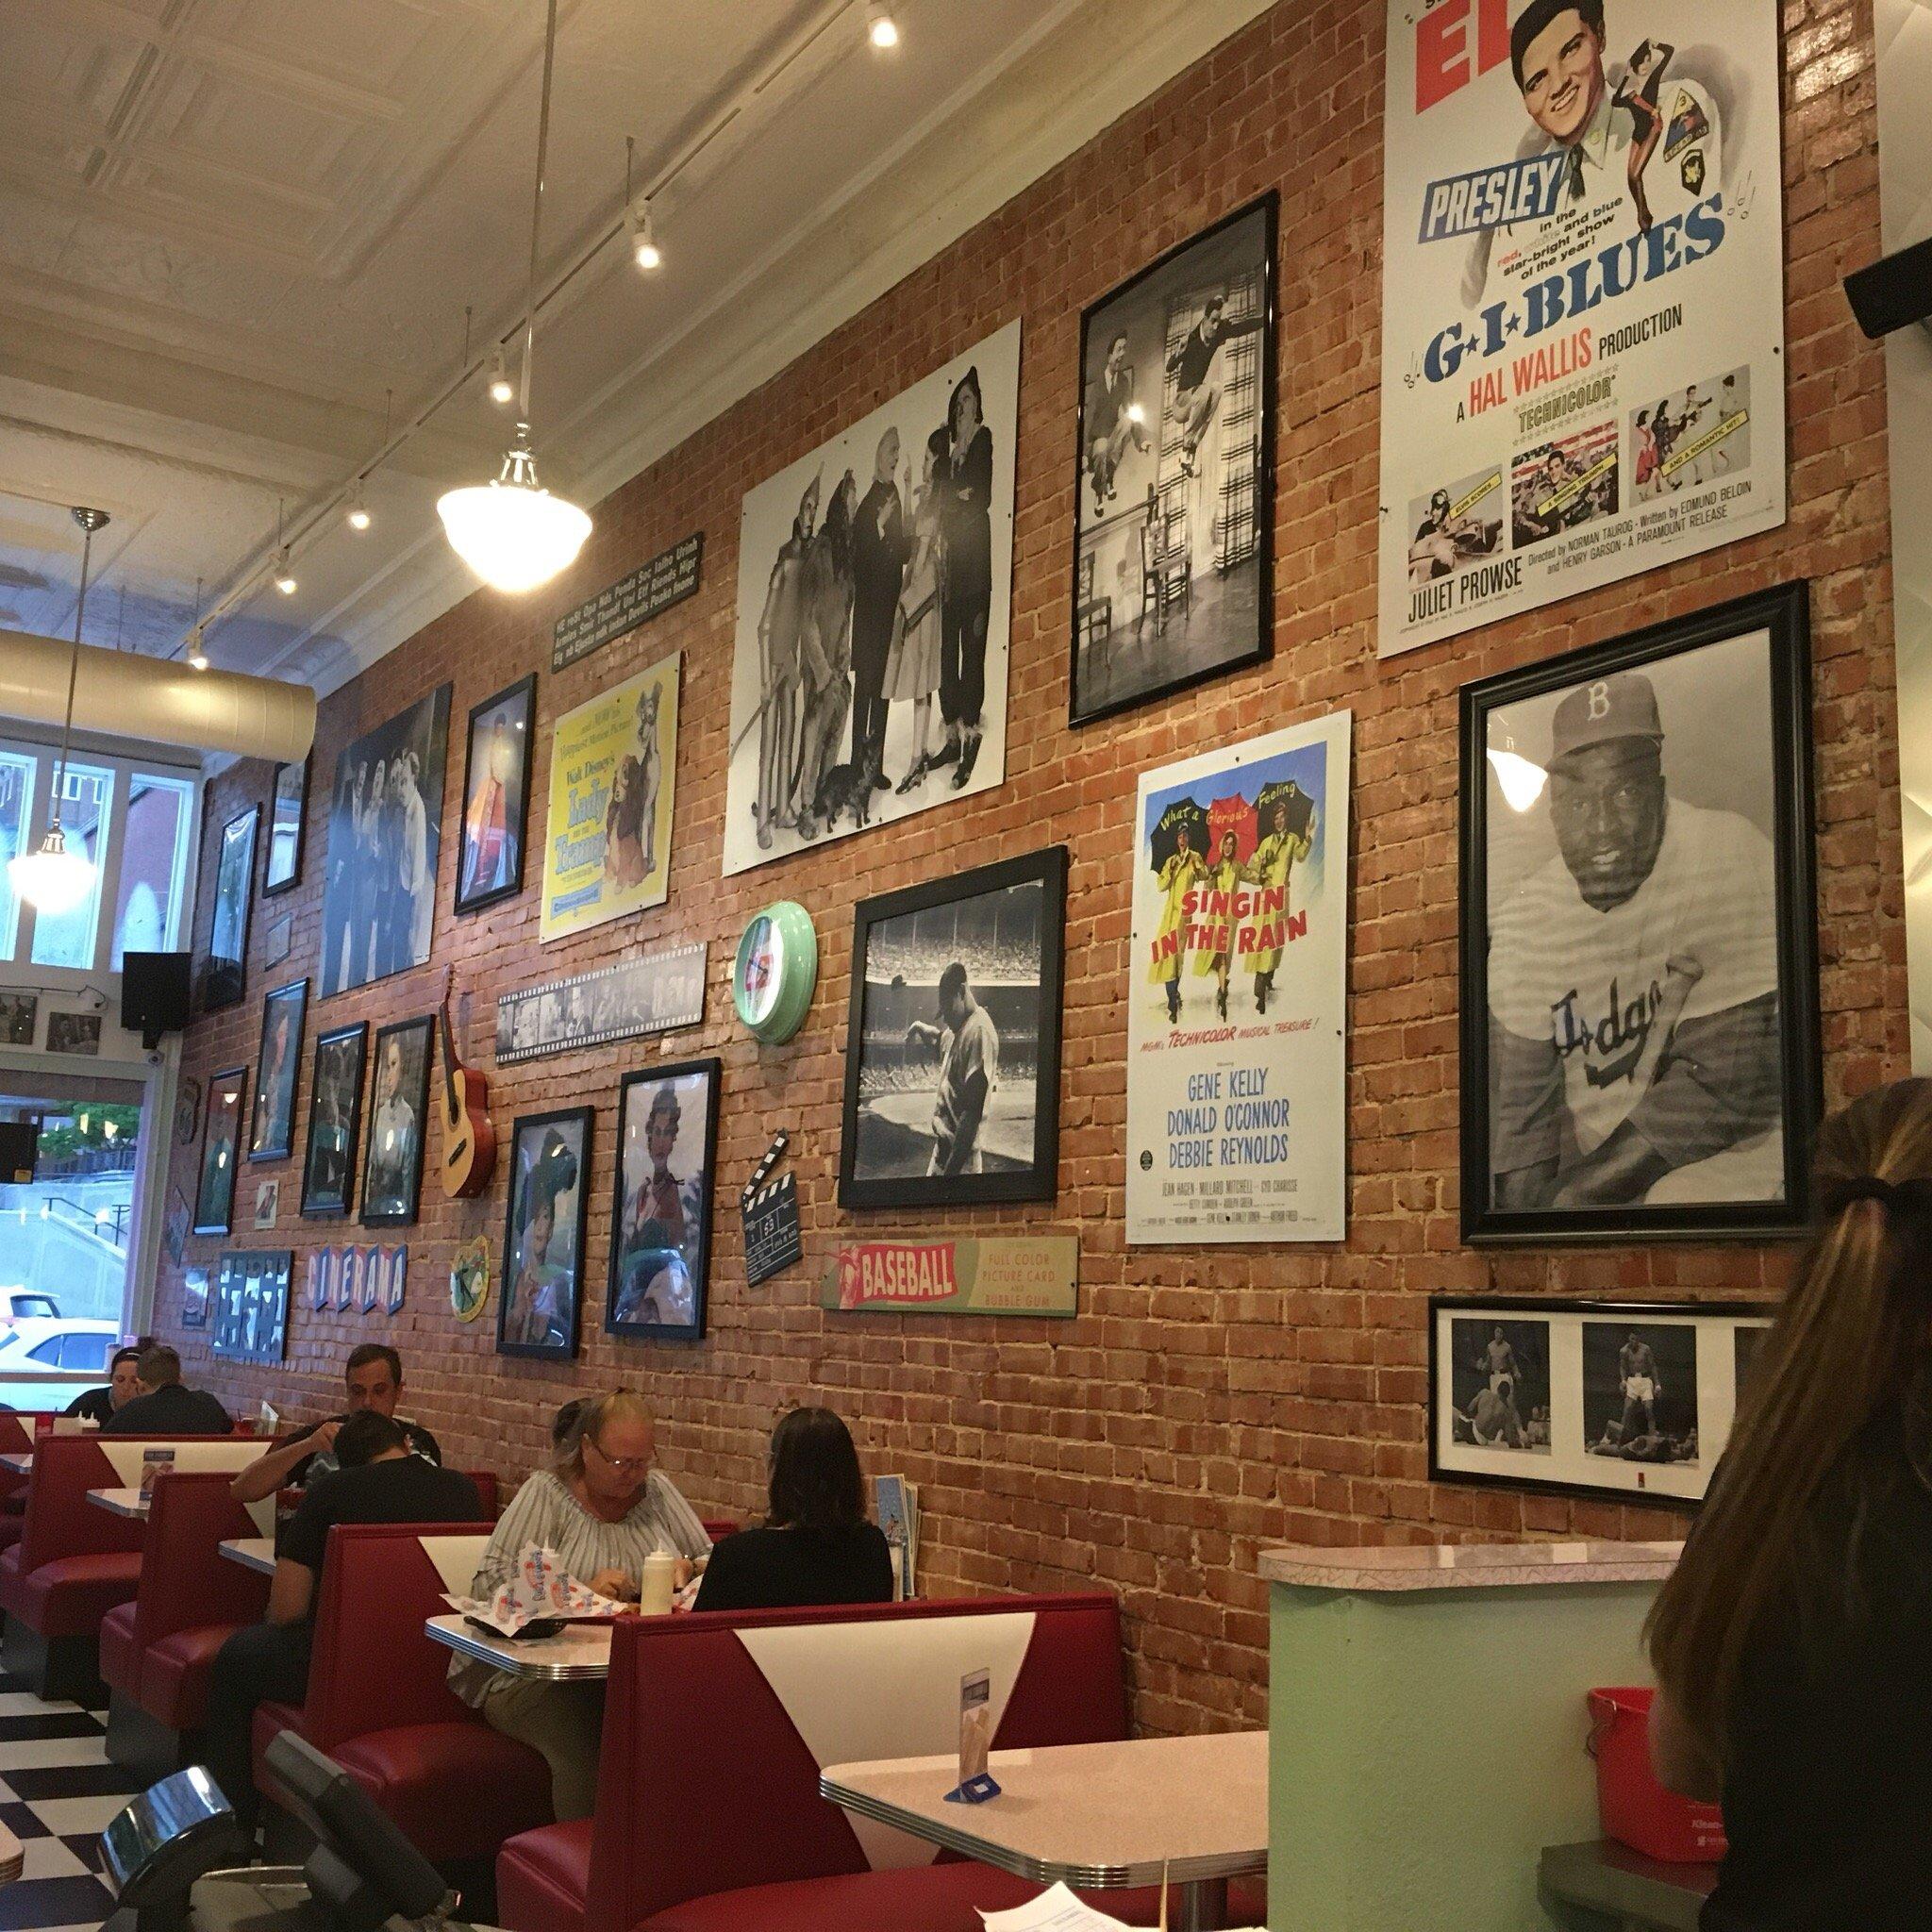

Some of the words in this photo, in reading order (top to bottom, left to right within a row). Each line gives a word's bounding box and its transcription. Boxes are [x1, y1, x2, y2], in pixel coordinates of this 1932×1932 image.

[1426, 157, 1562, 238] PRESLEY
[1540, 222, 1552, 233] in
[1556, 208, 1576, 225] the
[1497, 249, 1522, 268] red,
[1563, 212, 1589, 233] and
[1593, 196, 1624, 218] blue
[1504, 235, 1570, 276] star-bright
[1577, 213, 1615, 239] show
[1521, 266, 1533, 280] of
[1537, 257, 1557, 273] the
[1522, 192, 1725, 338] BLUES
[1456, 402, 1465, 424] A
[1470, 367, 1507, 418] HAL
[1512, 327, 1592, 397] WALLIS
[1599, 303, 1682, 360] PRODUCTION
[1519, 375, 1612, 433] TECHNICOLOR
[1528, 547, 1556, 566] Directed
[1558, 544, 1566, 557] by
[1568, 531, 1600, 552] NORMAN
[1603, 520, 1633, 541] TAUROG
[1640, 510, 1667, 527] Written
[1669, 506, 1678, 520] by
[1680, 491, 1717, 515] EDMUND
[1547, 561, 1559, 575] and
[1562, 554, 1588, 569] HENRY
[1591, 540, 1622, 560] GARSON
[1628, 536, 1634, 547] A
[1637, 518, 1686, 545] PARAMOUNT
[1690, 505, 1727, 528] RELEASE
[1408, 579, 1455, 623] JULIET
[1460, 556, 1523, 605] PROWSE
[1588, 681, 1610, 721] B
[568, 778, 610, 828] Lady
[1160, 806, 1191, 831] What
[1192, 811, 1200, 822] a
[1206, 807, 1249, 825] Glorious
[1258, 783, 1296, 809] Feeling
[1181, 885, 1286, 920] SINGIN
[1151, 928, 1179, 964] IN
[1185, 924, 1230, 953] THE
[1238, 909, 1307, 955] RAIN
[1168, 1025, 1237, 1049] TECHNICOLOR
[1238, 1025, 1271, 1039] MUSICAL
[1188, 1072, 1222, 1102] GENE
[1229, 1067, 1269, 1099] KELLY
[1168, 1106, 1217, 1137] DONALD
[1224, 1098, 1290, 1132] O'CONNOR
[1170, 1139, 1213, 1169] DEBBIE
[1221, 1134, 1289, 1166] REYNOLDS
[308, 1254, 403, 1306] CINERAMA
[862, 1249, 953, 1298] BASEBALL
[982, 1270, 1024, 1282] PICTURE
[1026, 1270, 1056, 1283] CARD
[990, 1254, 1012, 1266] FULL
[1015, 1253, 1050, 1266] COLOR
[984, 1294, 1021, 1307] BUBBLE
[1025, 1294, 1050, 1307] GUM
